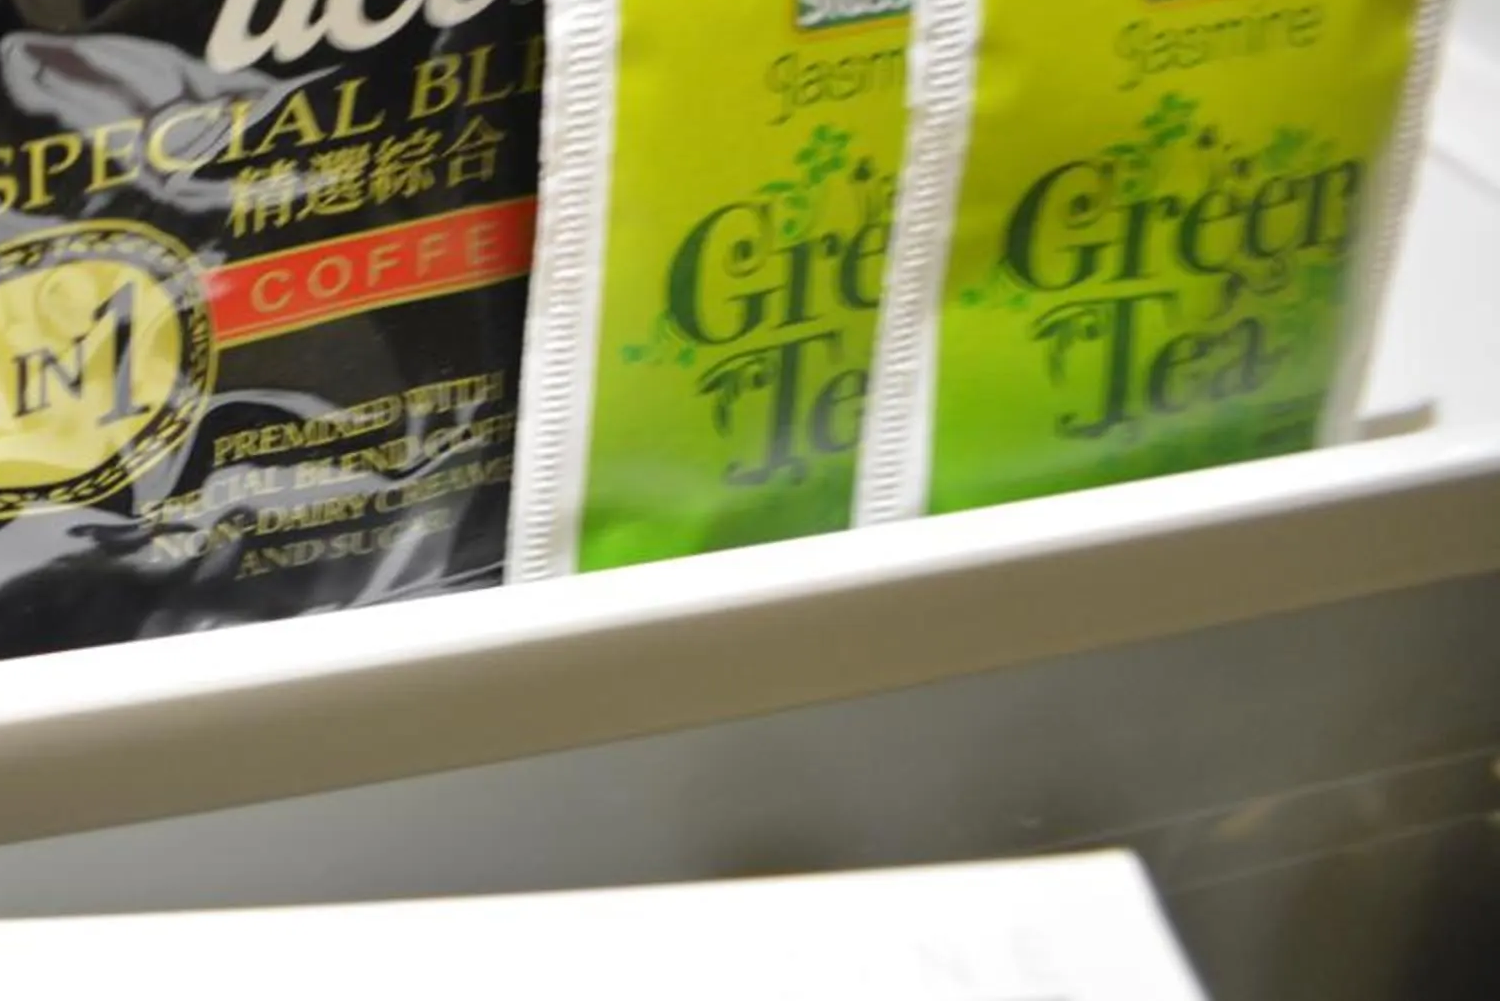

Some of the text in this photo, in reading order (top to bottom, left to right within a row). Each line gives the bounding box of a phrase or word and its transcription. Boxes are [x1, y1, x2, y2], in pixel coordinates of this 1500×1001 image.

[225, 115, 504, 239] 精選綜合
[1002, 156, 1366, 293] Green
[9, 333, 86, 418] IN
[91, 280, 152, 427] 1
[1031, 288, 1291, 442] Tea
